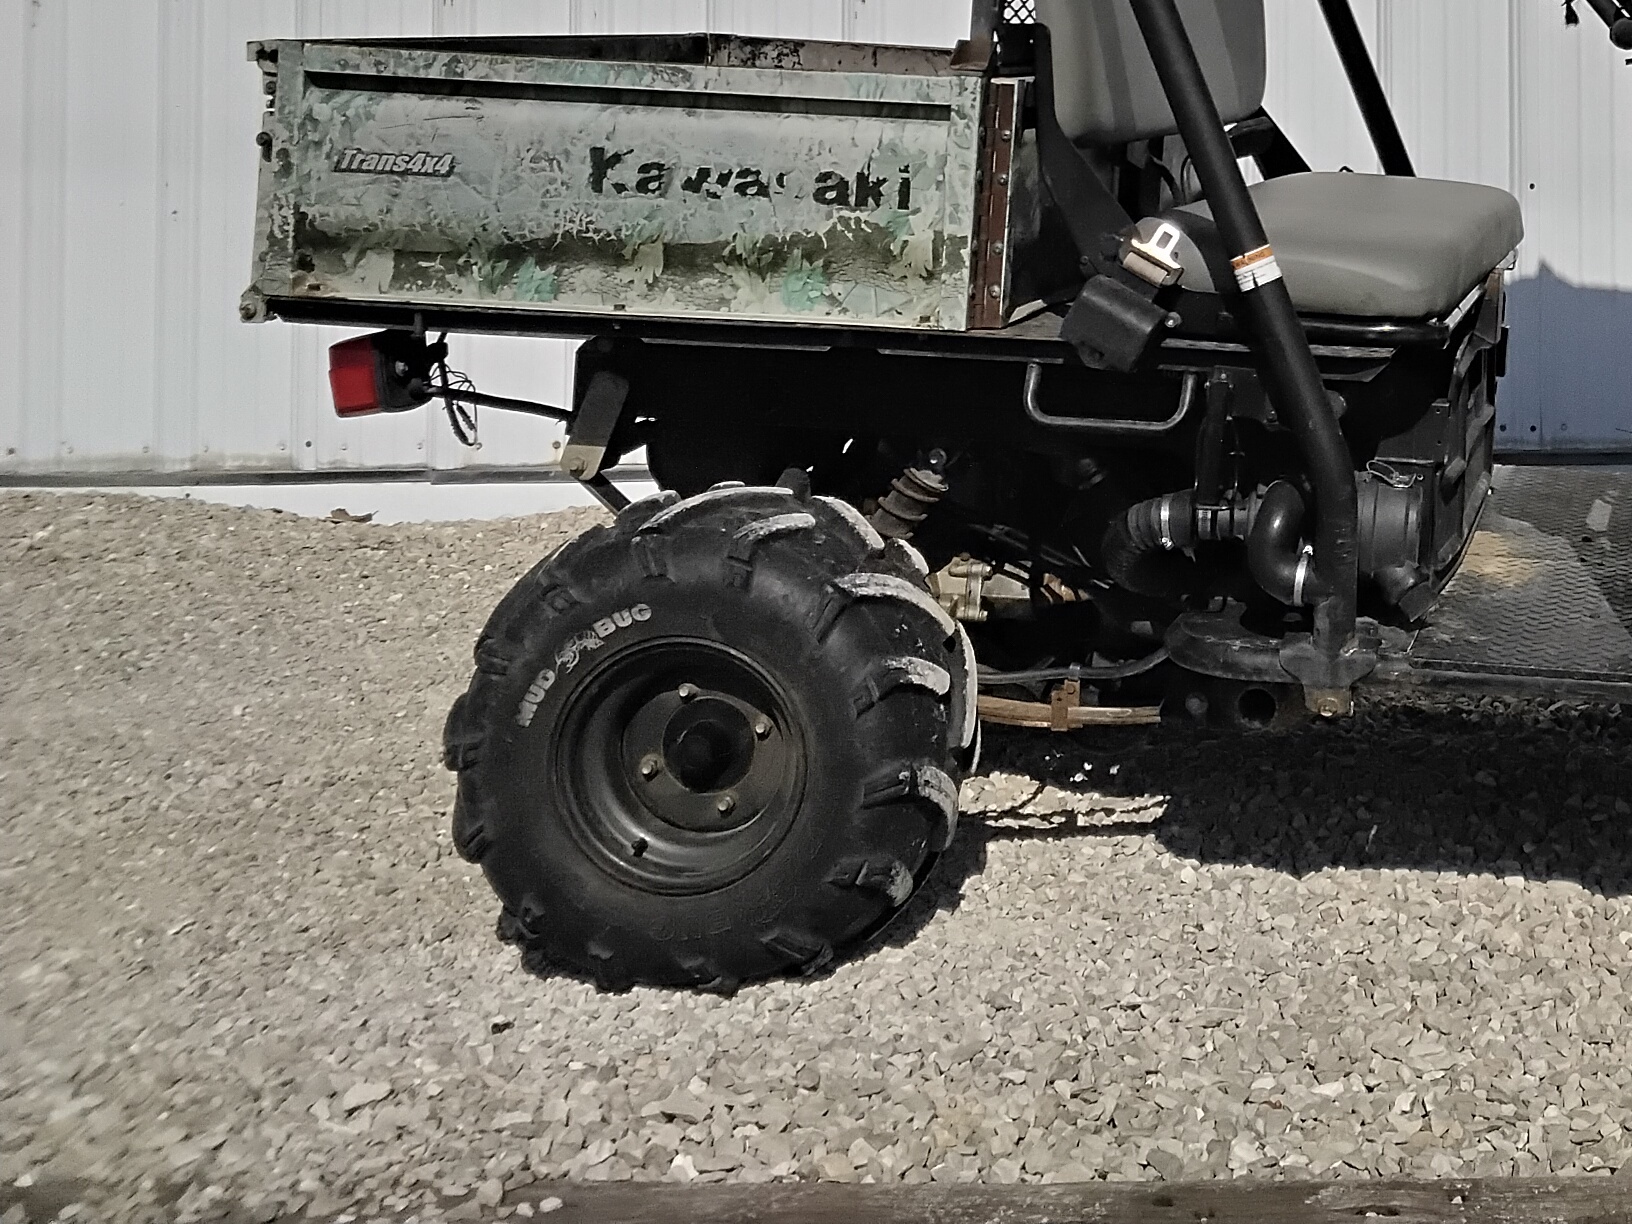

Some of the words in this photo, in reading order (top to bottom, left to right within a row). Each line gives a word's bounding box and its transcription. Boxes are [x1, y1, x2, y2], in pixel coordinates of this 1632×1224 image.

[337, 148, 454, 175] Trans4x4
[516, 668, 556, 727] MUD
[592, 602, 652, 638] BUG
